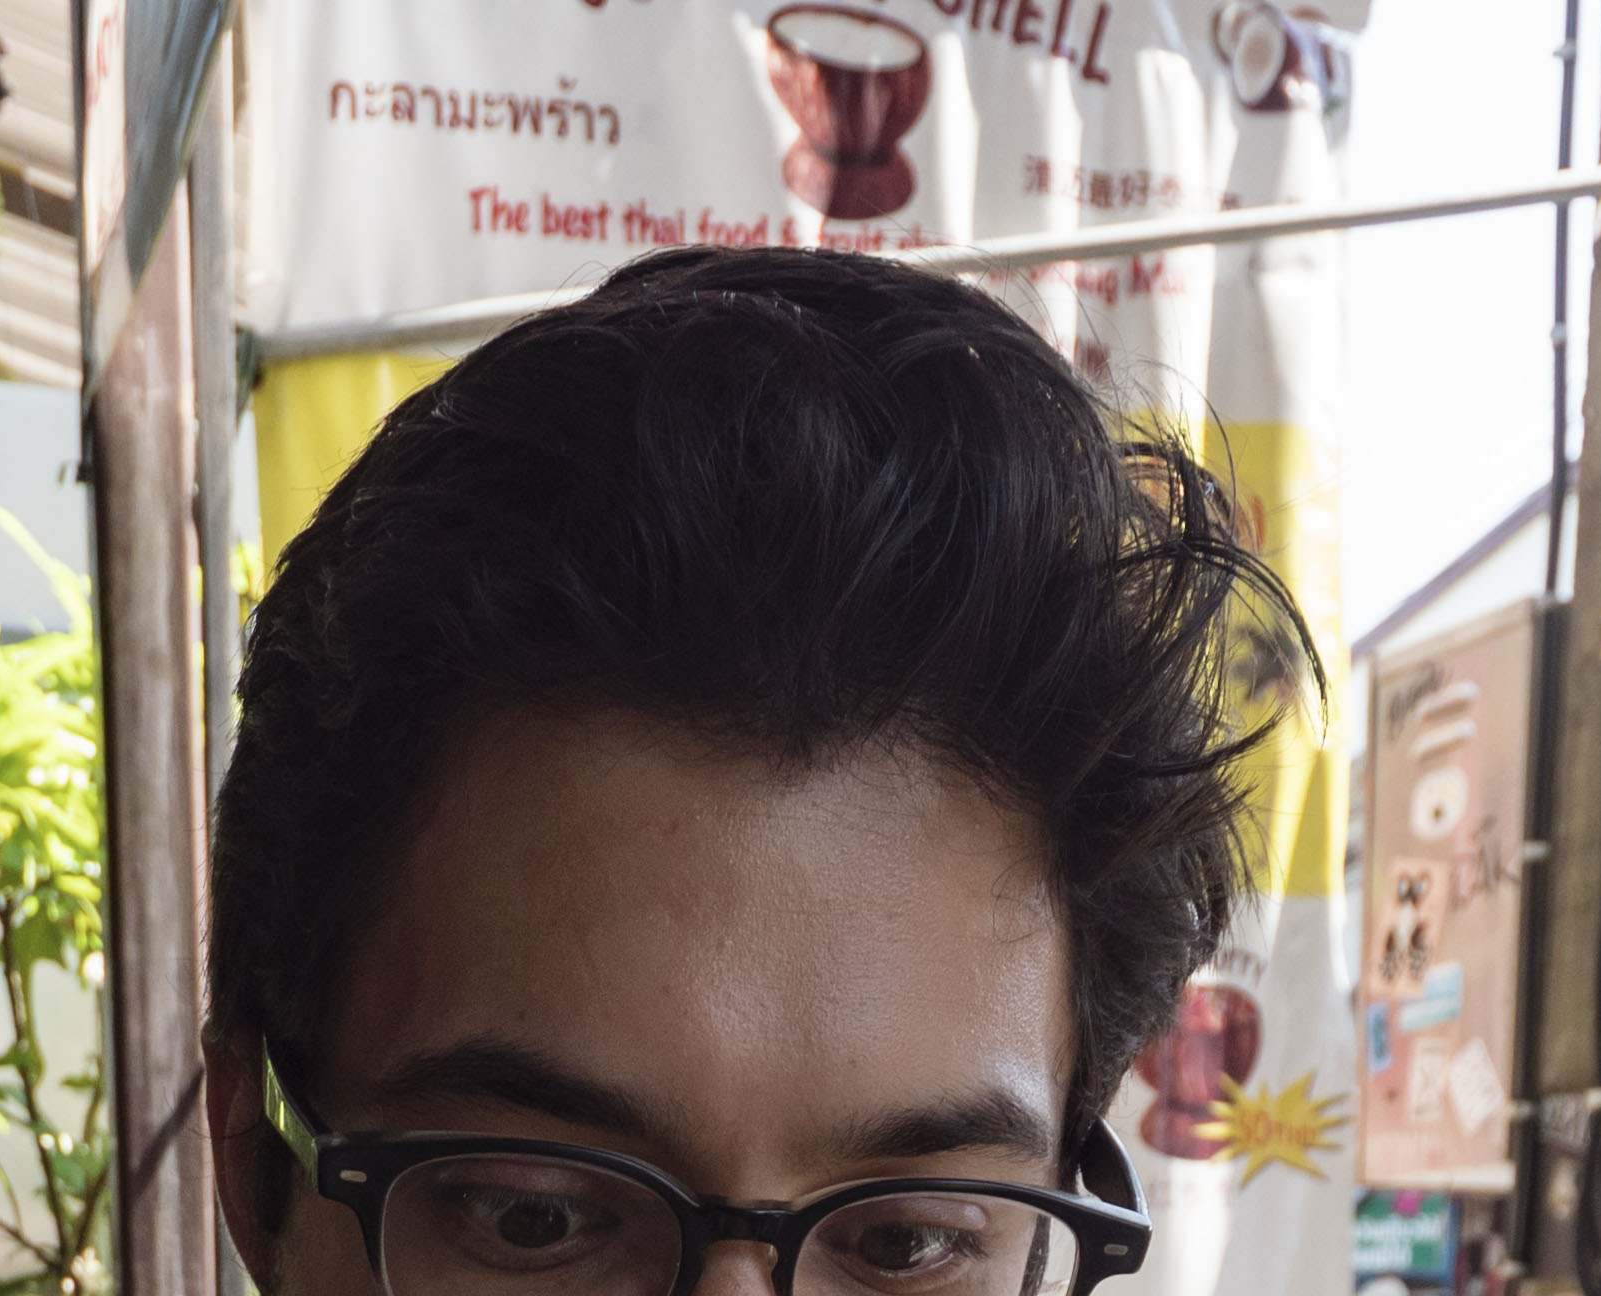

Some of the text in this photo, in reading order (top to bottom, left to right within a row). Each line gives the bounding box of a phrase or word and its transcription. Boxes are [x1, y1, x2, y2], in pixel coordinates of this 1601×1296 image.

[329, 74, 620, 147] กะลามะพร้าว
[468, 186, 529, 238] The
[541, 193, 612, 243] best
[623, 198, 684, 248] thai
[697, 206, 771, 248] food
